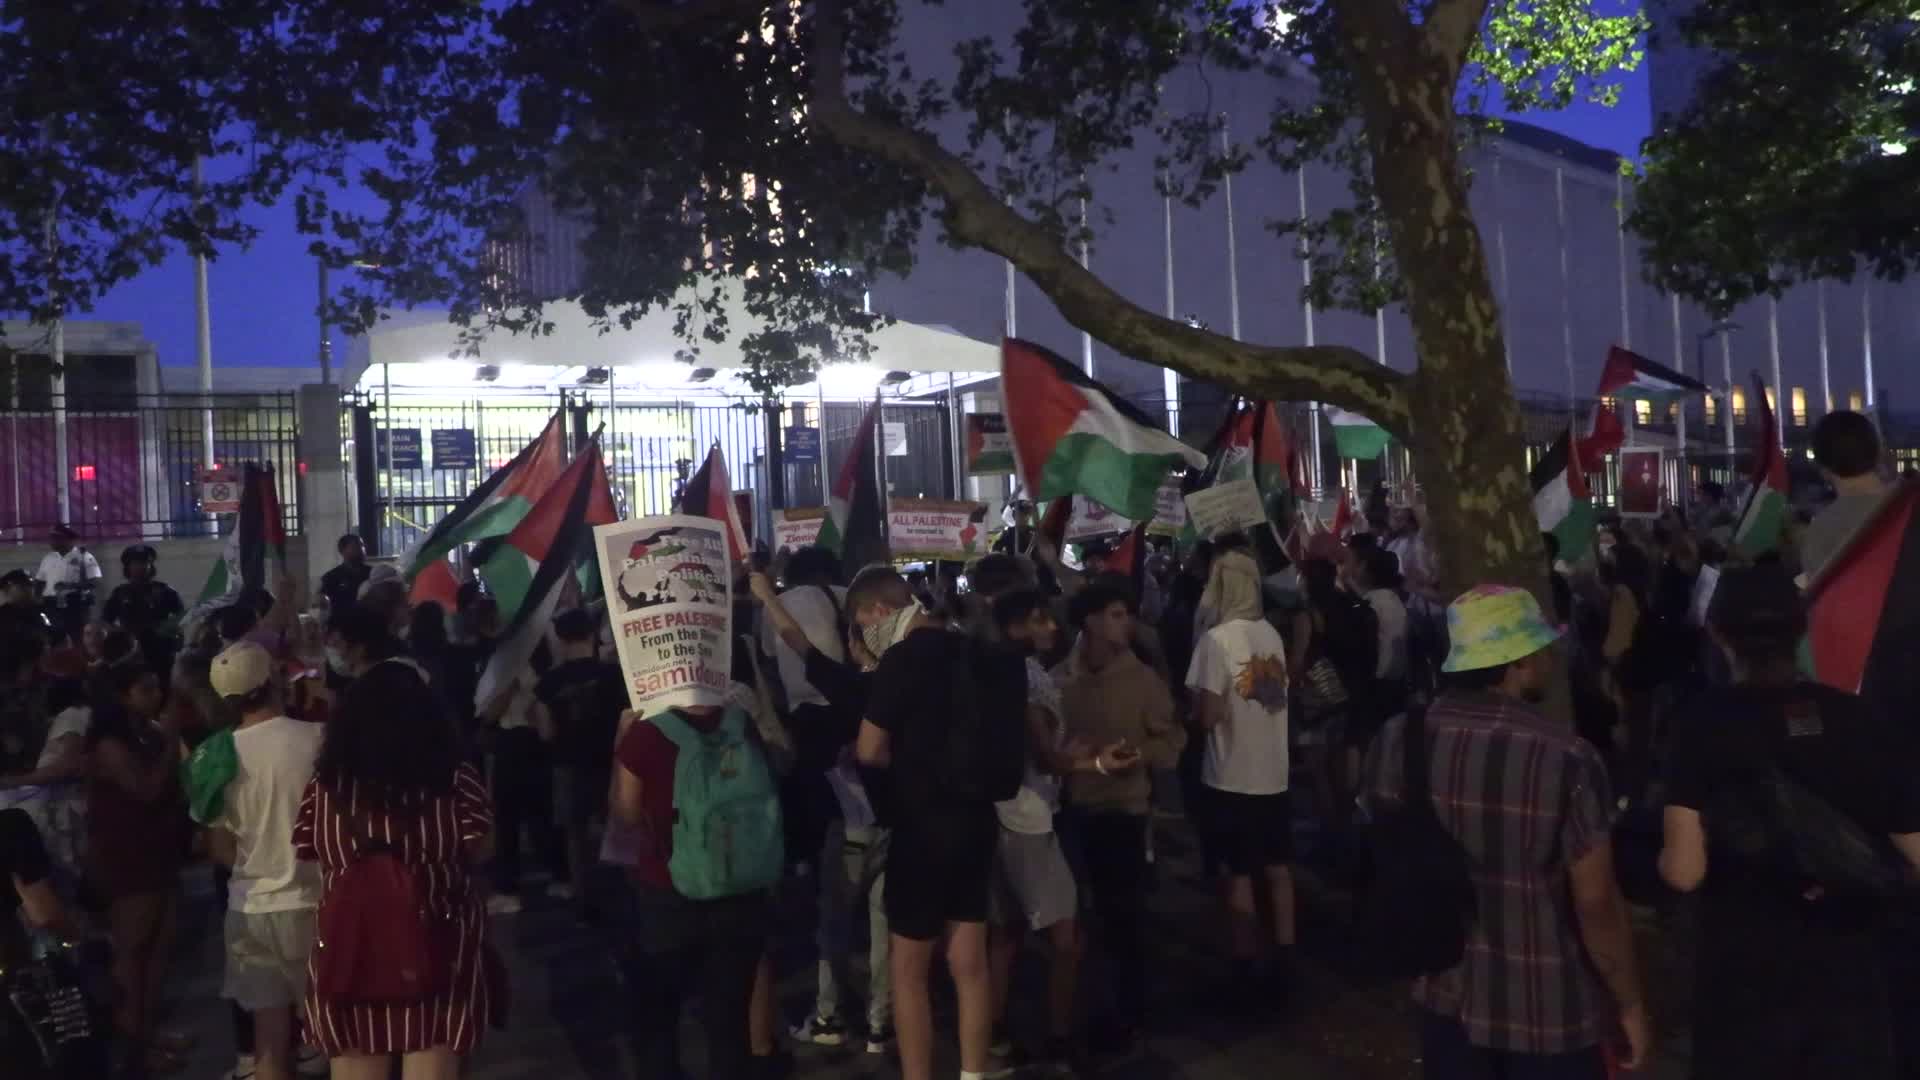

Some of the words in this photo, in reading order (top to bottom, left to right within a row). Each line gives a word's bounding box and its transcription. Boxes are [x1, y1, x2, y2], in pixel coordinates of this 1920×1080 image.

[379, 444, 418, 453] ETRANCE
[892, 515, 911, 525] ALL
[623, 615, 662, 638] FREE
[640, 631, 674, 649] From
[677, 627, 699, 641] the
[658, 648, 671, 660] to
[674, 643, 696, 657] the
